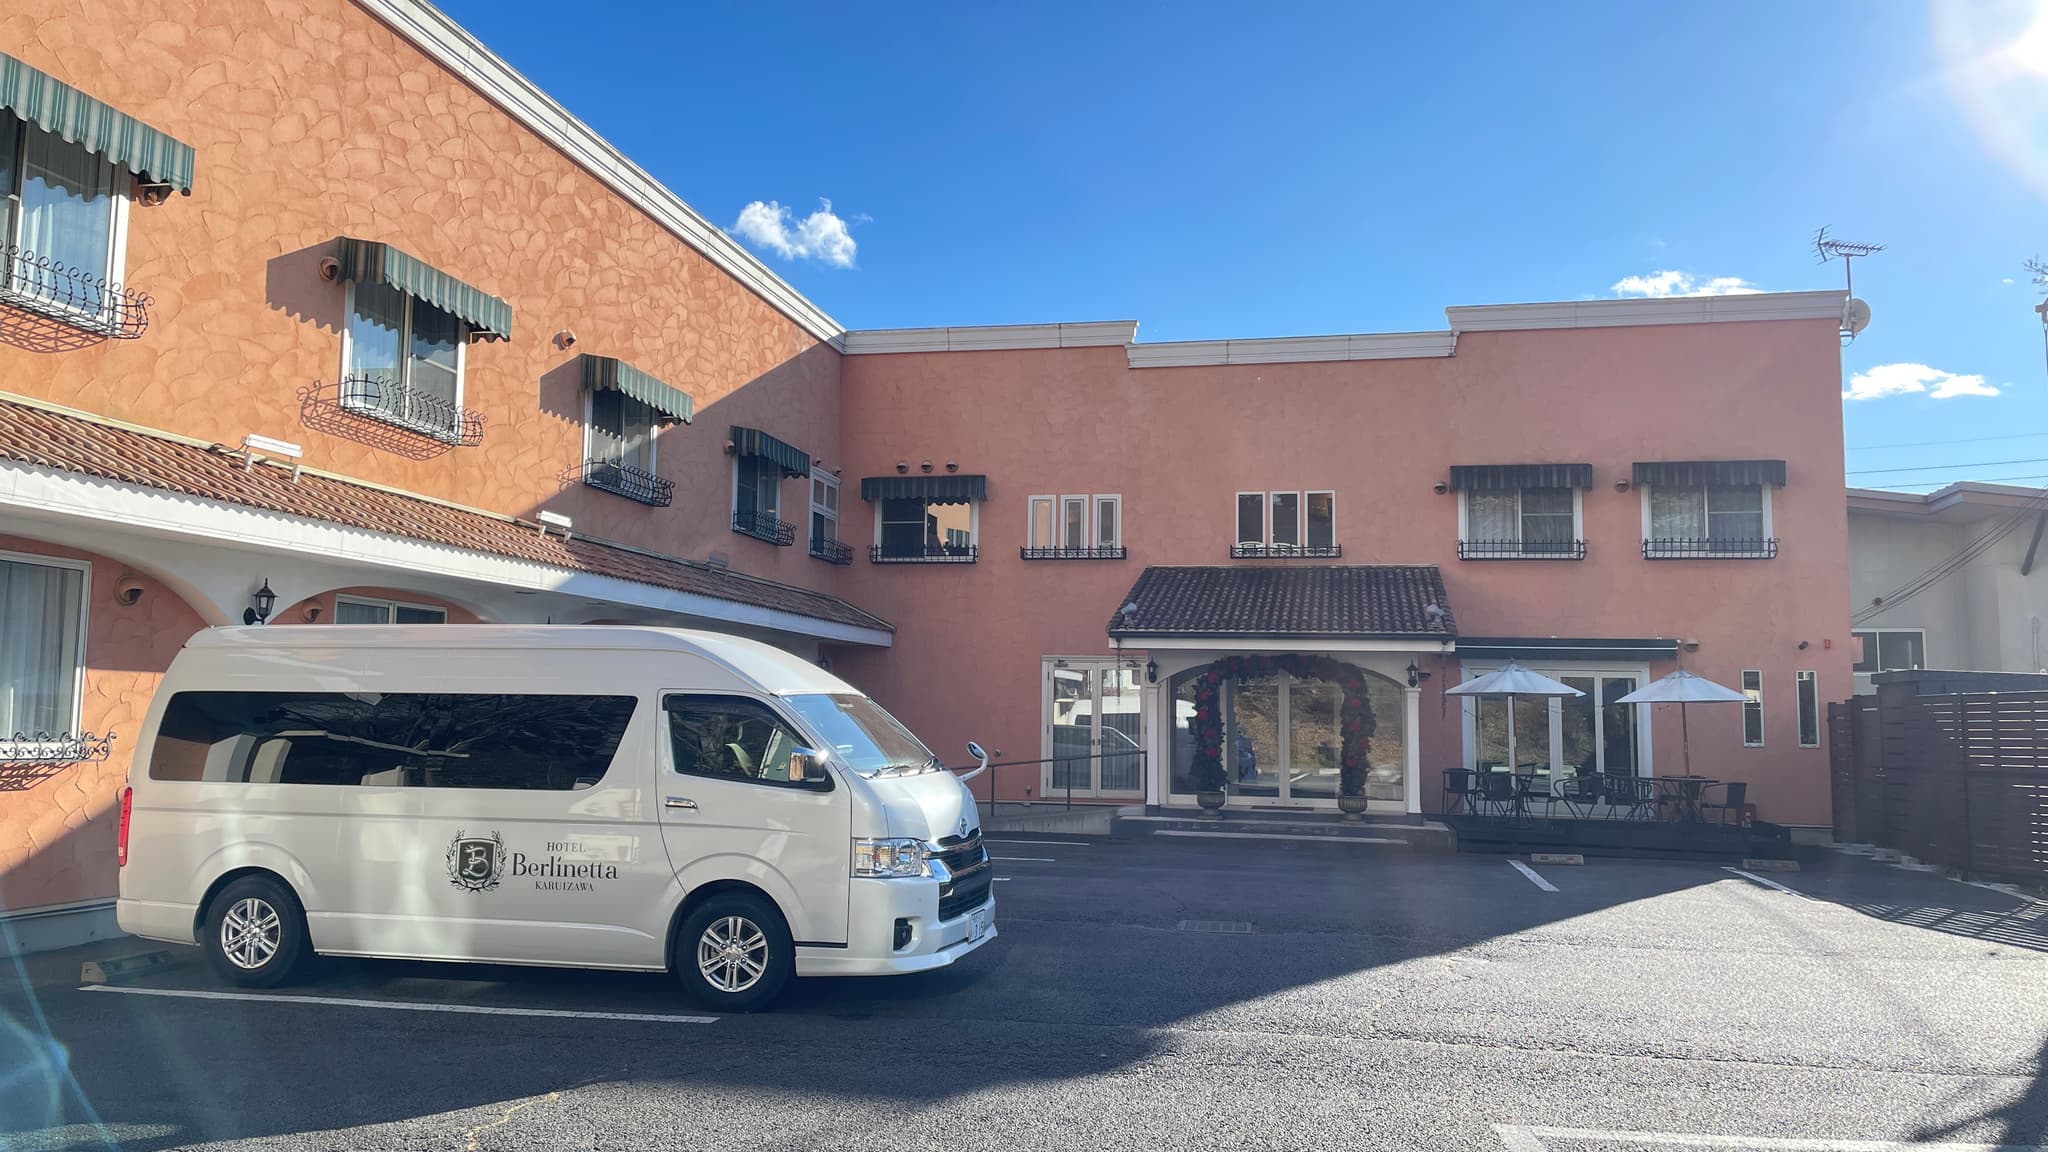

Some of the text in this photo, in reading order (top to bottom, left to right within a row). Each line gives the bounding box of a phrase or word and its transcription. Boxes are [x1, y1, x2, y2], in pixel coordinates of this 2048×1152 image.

[546, 841, 586, 852] HOTEL
[512, 852, 618, 879] Berlinetta
[535, 880, 594, 892] KARUIZAWA
